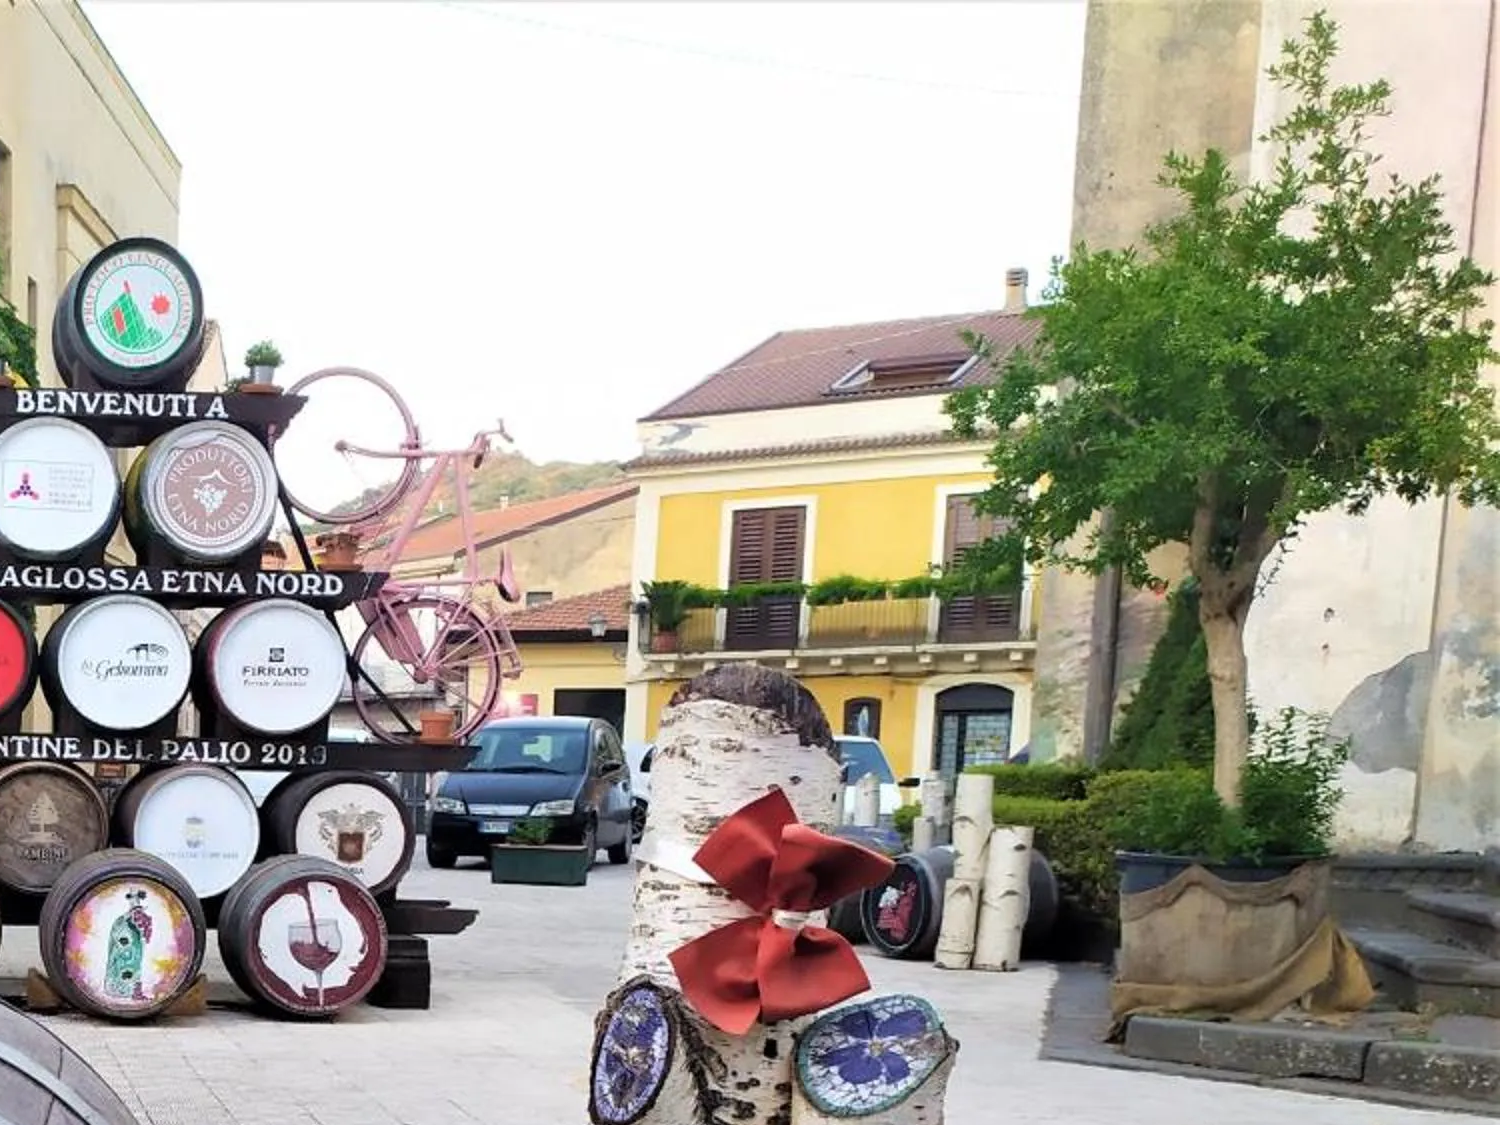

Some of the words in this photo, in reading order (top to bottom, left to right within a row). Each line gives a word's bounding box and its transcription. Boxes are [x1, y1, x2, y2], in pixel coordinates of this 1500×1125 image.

[16, 389, 197, 418] BENVENUTI
[203, 395, 229, 419] A
[160, 570, 246, 595] ETNA
[254, 571, 345, 597] NORD
[241, 665, 310, 677] FIRRIATO
[92, 738, 153, 761] DEL
[160, 739, 252, 764] PALIO
